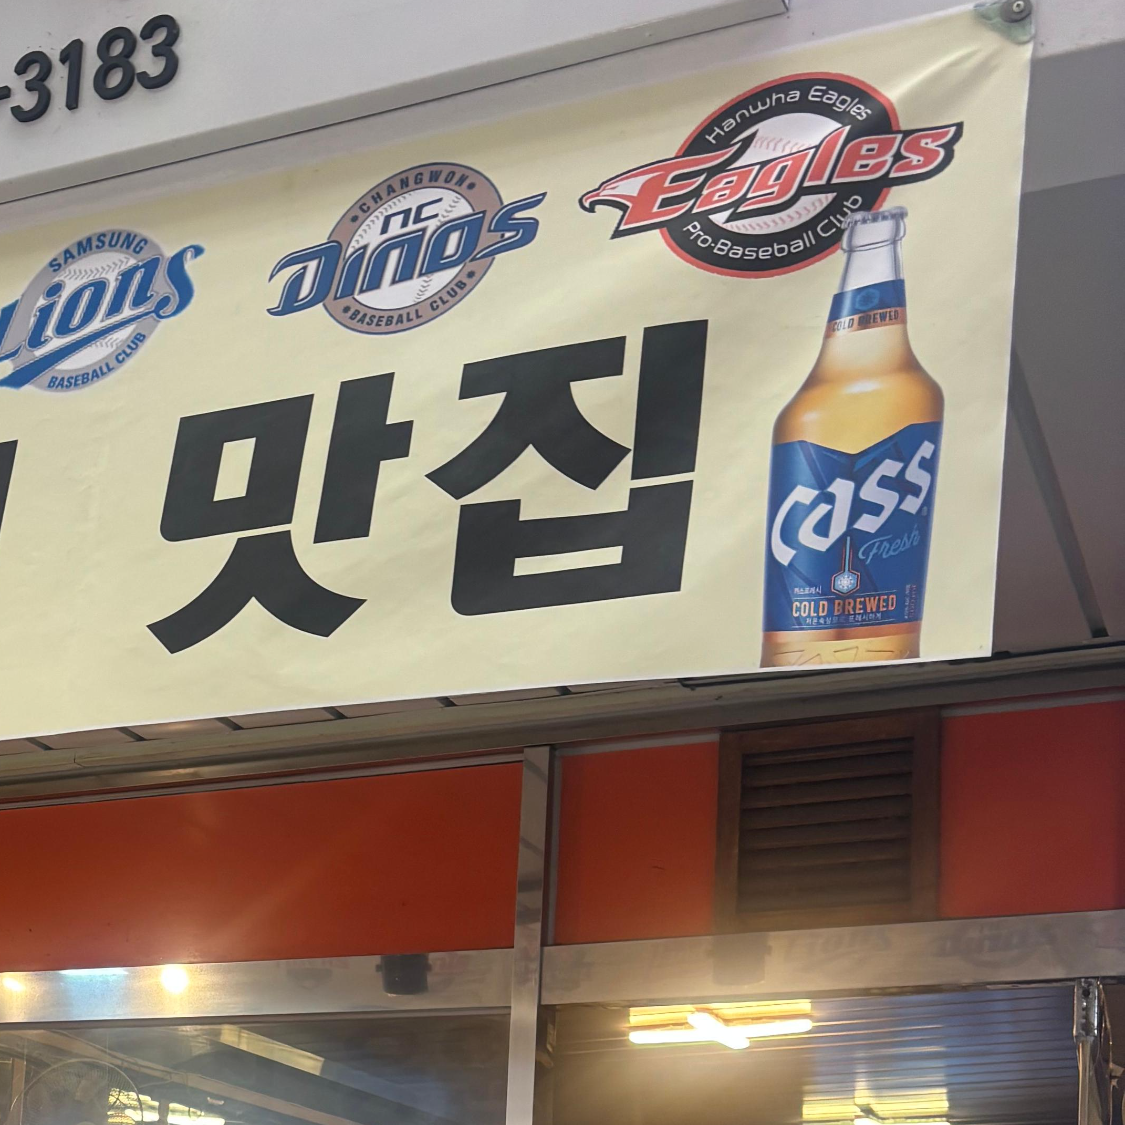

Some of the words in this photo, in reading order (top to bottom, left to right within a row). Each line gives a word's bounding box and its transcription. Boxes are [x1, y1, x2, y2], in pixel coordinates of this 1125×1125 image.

[704, 87, 801, 144] Hanwha
[807, 85, 873, 122] Eagles
[359, 169, 469, 215] CHANGWON
[578, 121, 964, 240] Eagles
[682, 219, 816, 260] Pro-Baseball
[817, 194, 863, 240] Club
[48, 230, 149, 273] SAMSUNG
[347, 304, 423, 327] BASEBALL
[429, 280, 468, 312] CLUB
[830, 316, 855, 333] COLD
[47, 362, 115, 390] BASEBALL
[114, 331, 147, 364] CLUB
[146, 319, 709, 655] 맛집
[858, 523, 921, 566] Fresh
[792, 601, 828, 618] COLD
[834, 594, 897, 616] BREWED
